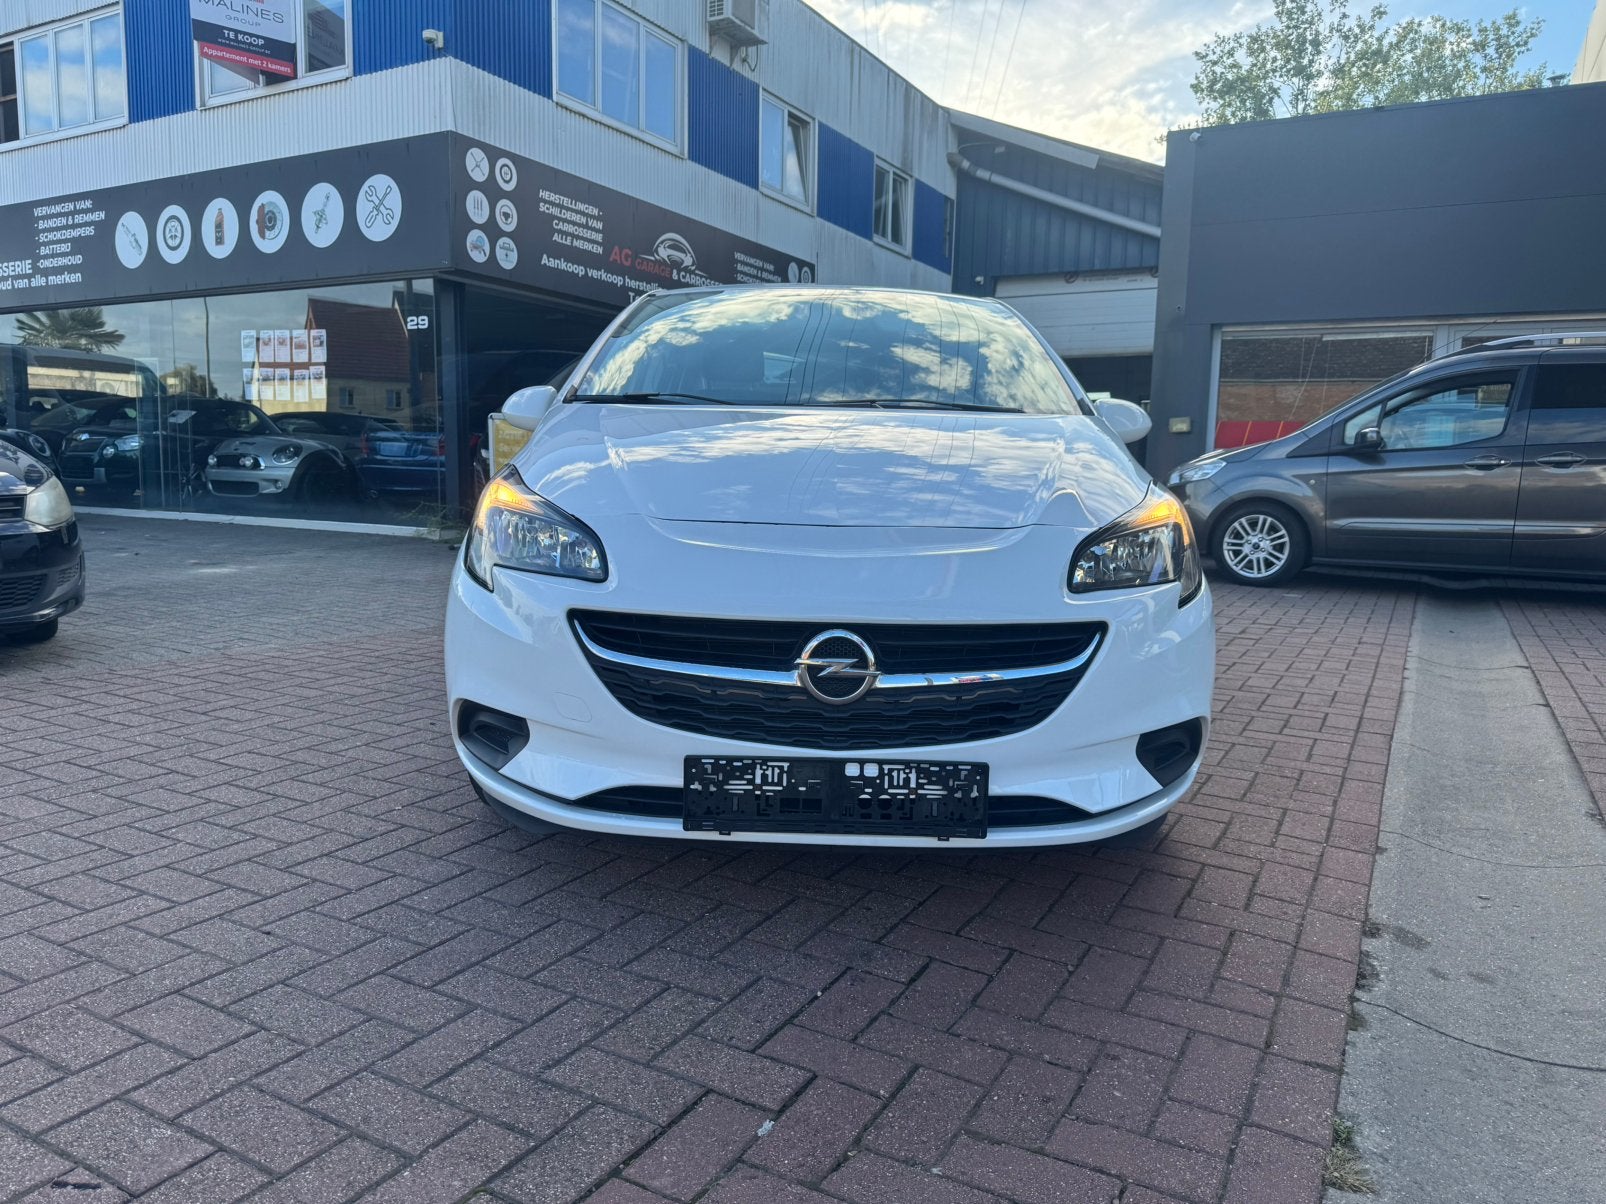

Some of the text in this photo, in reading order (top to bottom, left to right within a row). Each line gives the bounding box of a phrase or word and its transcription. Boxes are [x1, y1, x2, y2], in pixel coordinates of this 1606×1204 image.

[225, 14, 262, 27] GROUP
[223, 29, 265, 46] TE KOOP
[203, 46, 247, 63] Appartement
[248, 58, 262, 67] met
[268, 62, 291, 73] kamers
[33, 199, 93, 217] VERVANGEN VAN:
[539, 189, 599, 216] HERSTELLINGEN
[38, 211, 105, 229] BANDEN & REMMEN
[539, 202, 603, 230] SCHILDEREN VAN
[39, 226, 95, 242] SCHOKDEMPERS
[552, 219, 603, 242] CARROSSERIE
[552, 232, 603, 255] ALLE MERKEN
[541, 253, 662, 292] Aankoop verkoop herstelli
[609, 245, 723, 287] AG GARAGE & CARROSSE
[13, 279, 29, 289] van
[30, 274, 46, 288] alle
[48, 271, 82, 285] merken
[407, 315, 429, 330] 29
